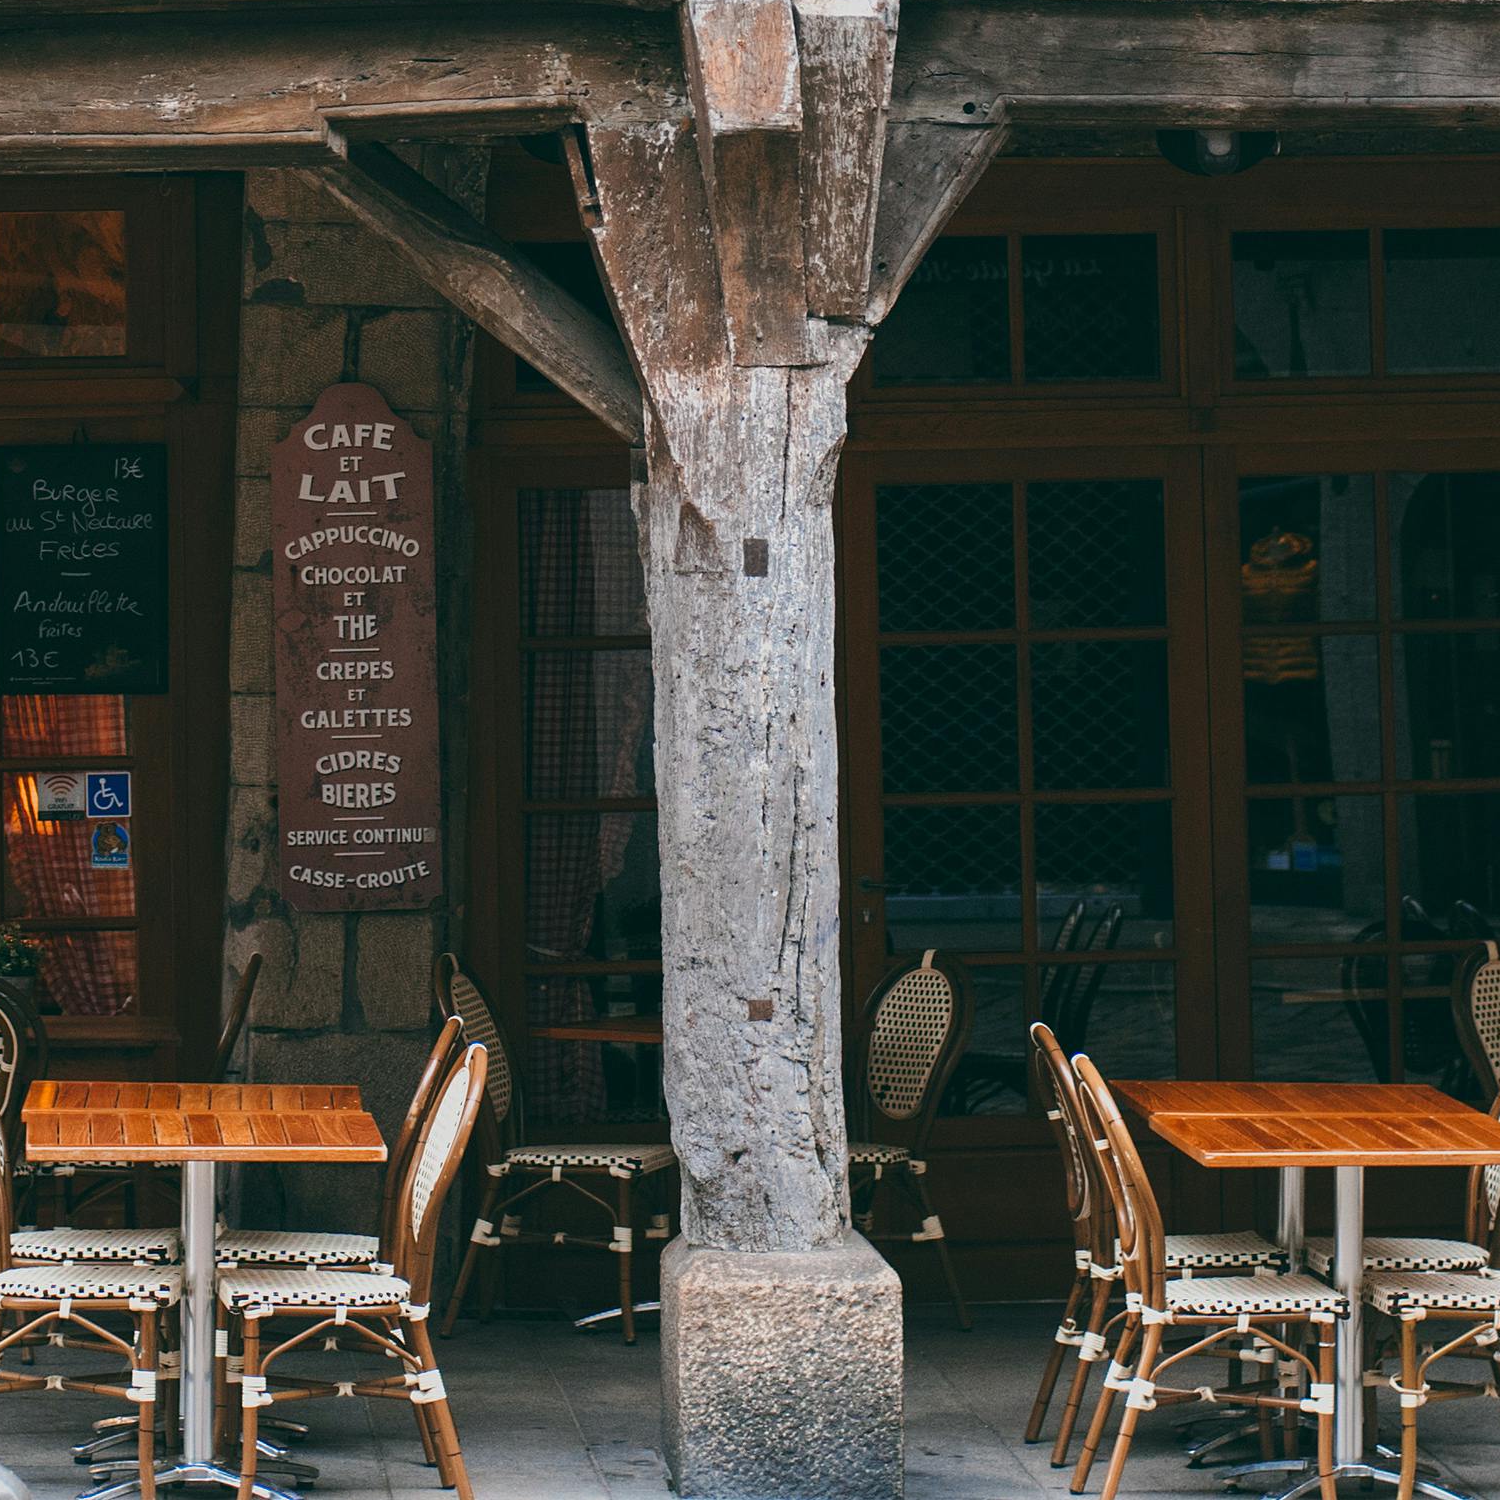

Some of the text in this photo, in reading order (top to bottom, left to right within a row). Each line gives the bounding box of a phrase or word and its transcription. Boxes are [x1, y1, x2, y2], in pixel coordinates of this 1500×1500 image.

[303, 422, 395, 451] CAFE
[339, 456, 363, 472] ET
[298, 472, 406, 504] LAIT
[284, 525, 420, 560] CAPPUCCINO
[300, 565, 407, 585] CHOCOLAT
[343, 591, 366, 607] ET
[332, 614, 378, 641] THE
[316, 660, 394, 681] CREPES
[347, 688, 366, 701] ET
[300, 708, 412, 729] GALETTES
[315, 750, 401, 775] CIDRES
[322, 782, 396, 808] BIERES
[287, 829, 349, 846] SERVICE
[289, 860, 430, 889] CASSE-CROUTE
